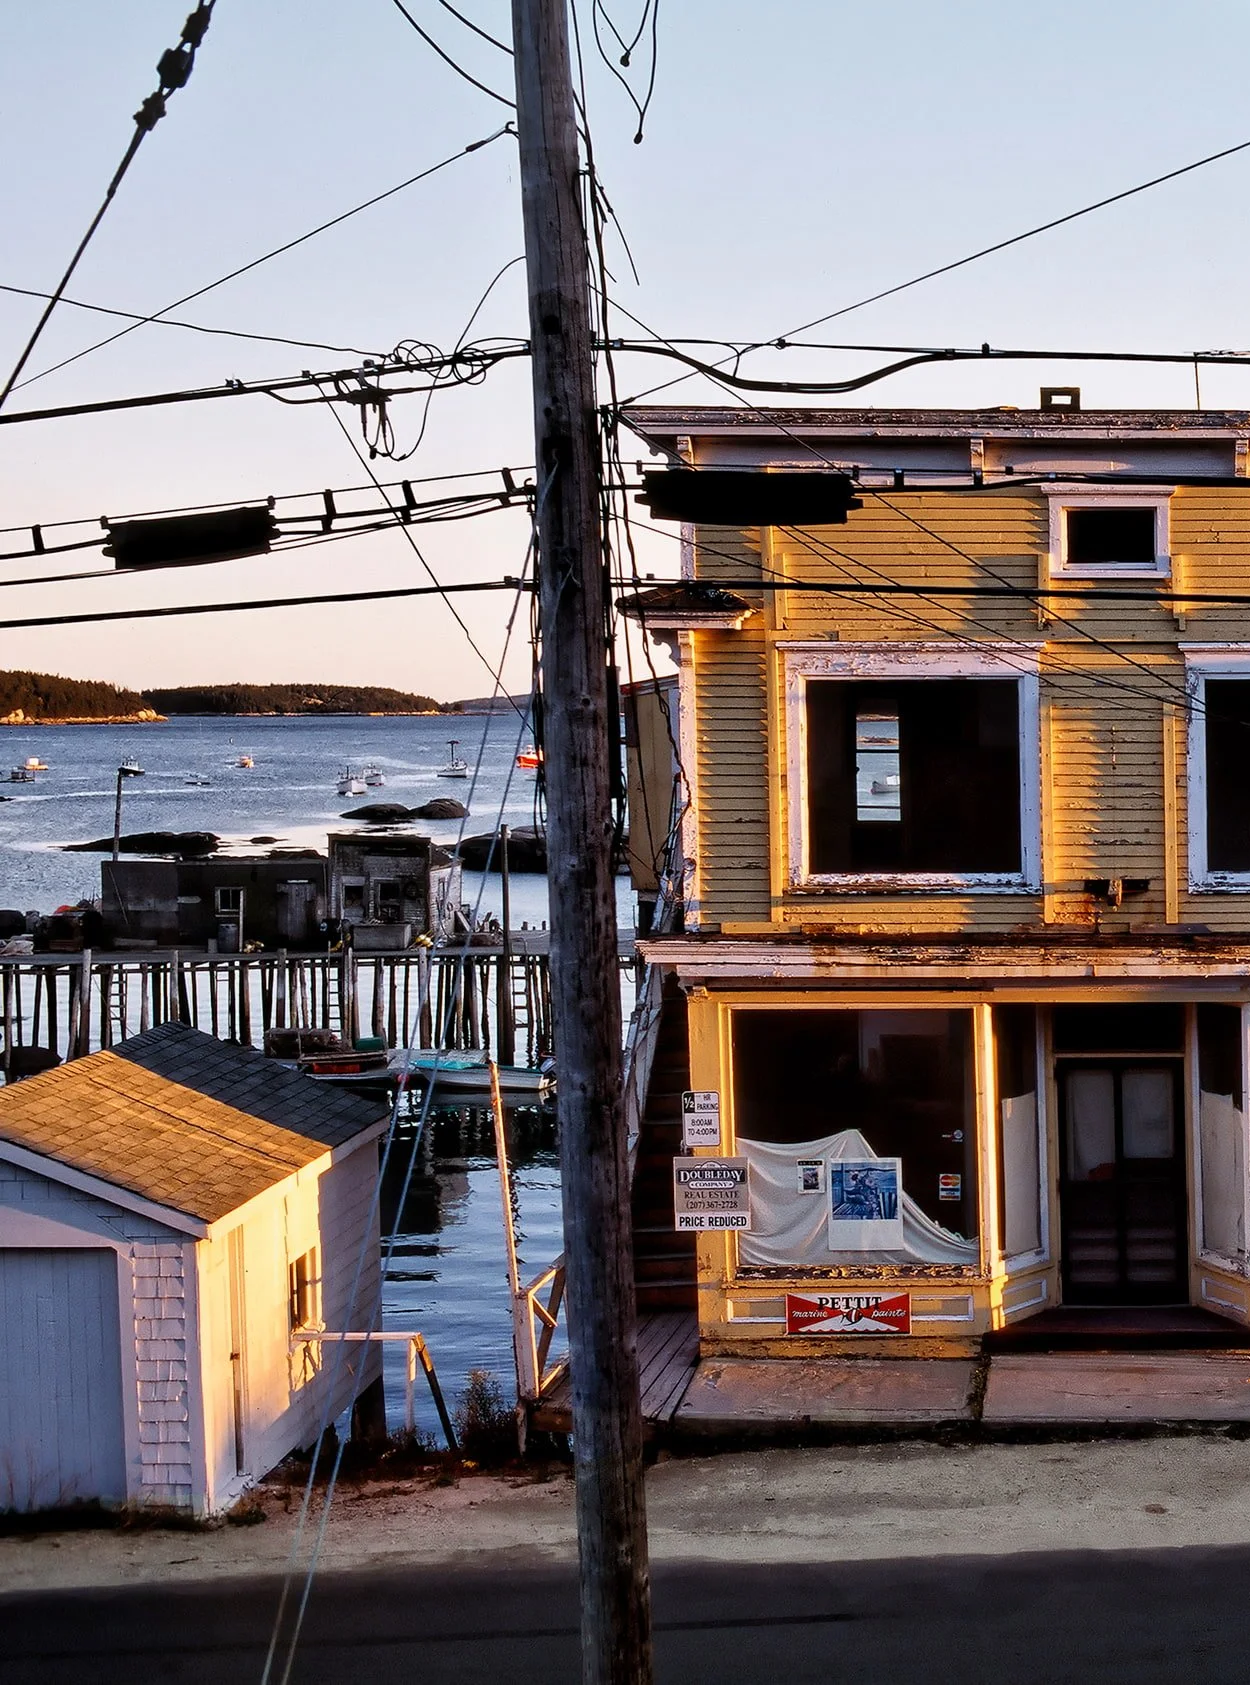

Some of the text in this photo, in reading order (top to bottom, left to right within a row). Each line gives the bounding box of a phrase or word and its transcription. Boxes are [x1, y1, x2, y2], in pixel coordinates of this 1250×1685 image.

[680, 1170, 743, 1182] DOUBLEDAY
[684, 1190, 740, 1199] REAL ESTATE
[680, 1216, 747, 1227] PRICE REDUCED
[817, 1296, 882, 1310] PETTIT
[792, 1307, 907, 1319] marine paints
